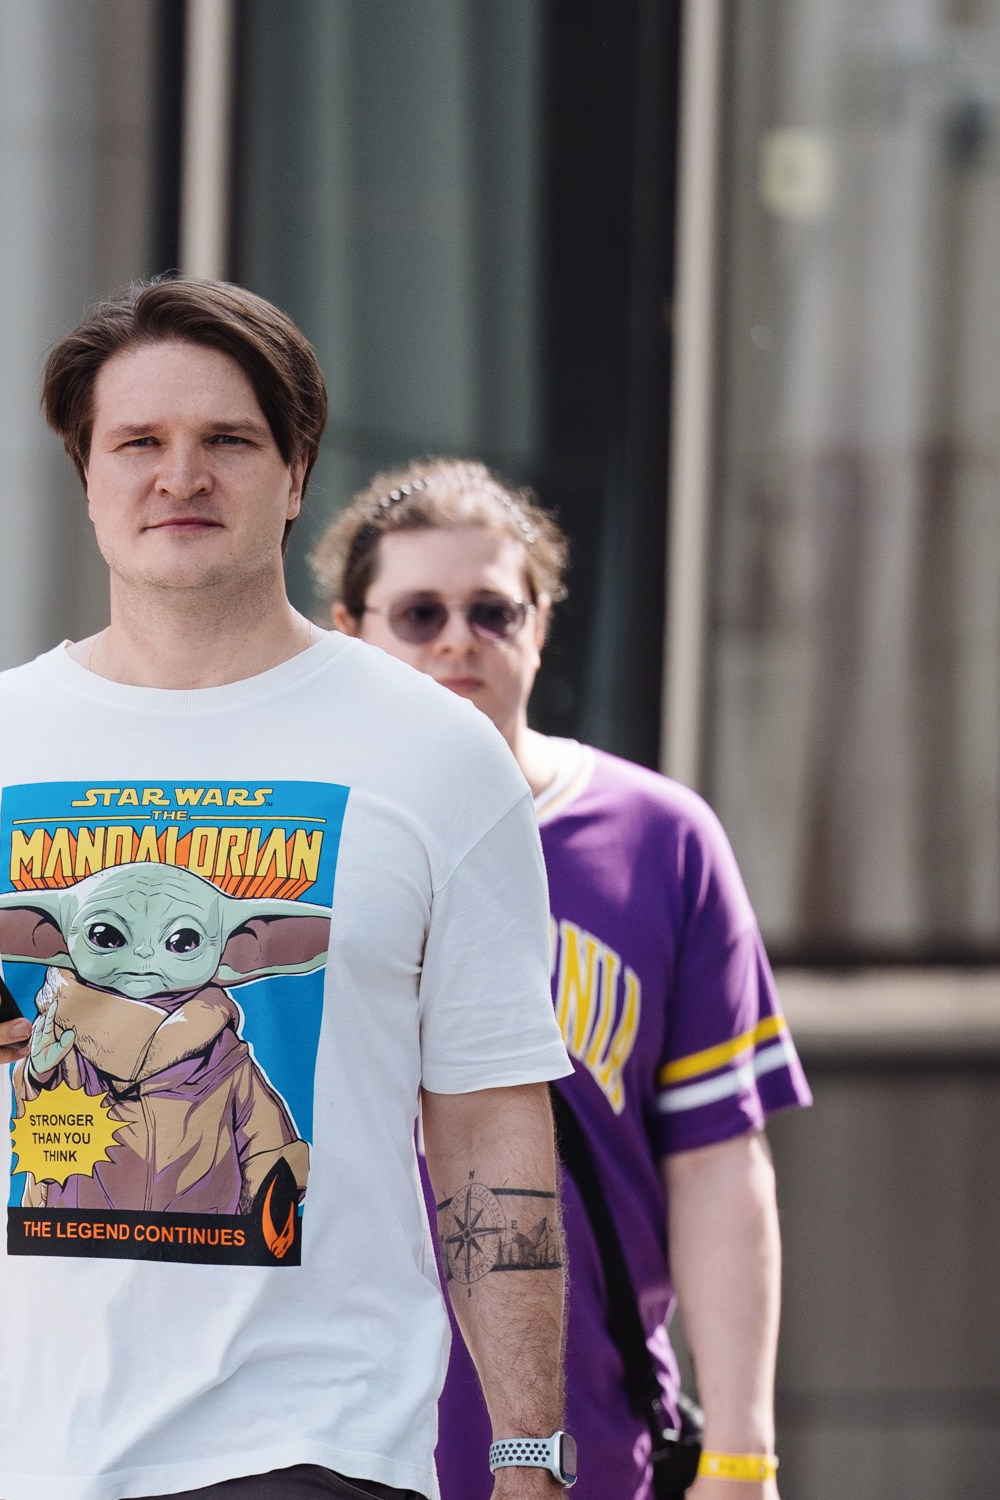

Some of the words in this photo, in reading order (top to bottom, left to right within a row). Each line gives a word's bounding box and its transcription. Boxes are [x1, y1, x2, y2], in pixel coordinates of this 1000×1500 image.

[71, 787, 171, 807] STAR
[174, 787, 274, 807] WARS
[151, 809, 190, 821] THE
[9, 825, 325, 889] MANDALORIAN
[29, 1113, 94, 1127] STRONGER
[32, 1132, 62, 1144] THAN
[65, 1132, 91, 1145] YOU
[43, 1150, 78, 1162] THINK
[468, 1170, 476, 1180] N
[510, 1220, 518, 1230] E
[23, 1221, 52, 1238] THE
[56, 1222, 130, 1240] LEGEND
[133, 1224, 246, 1246] CONTINUES
